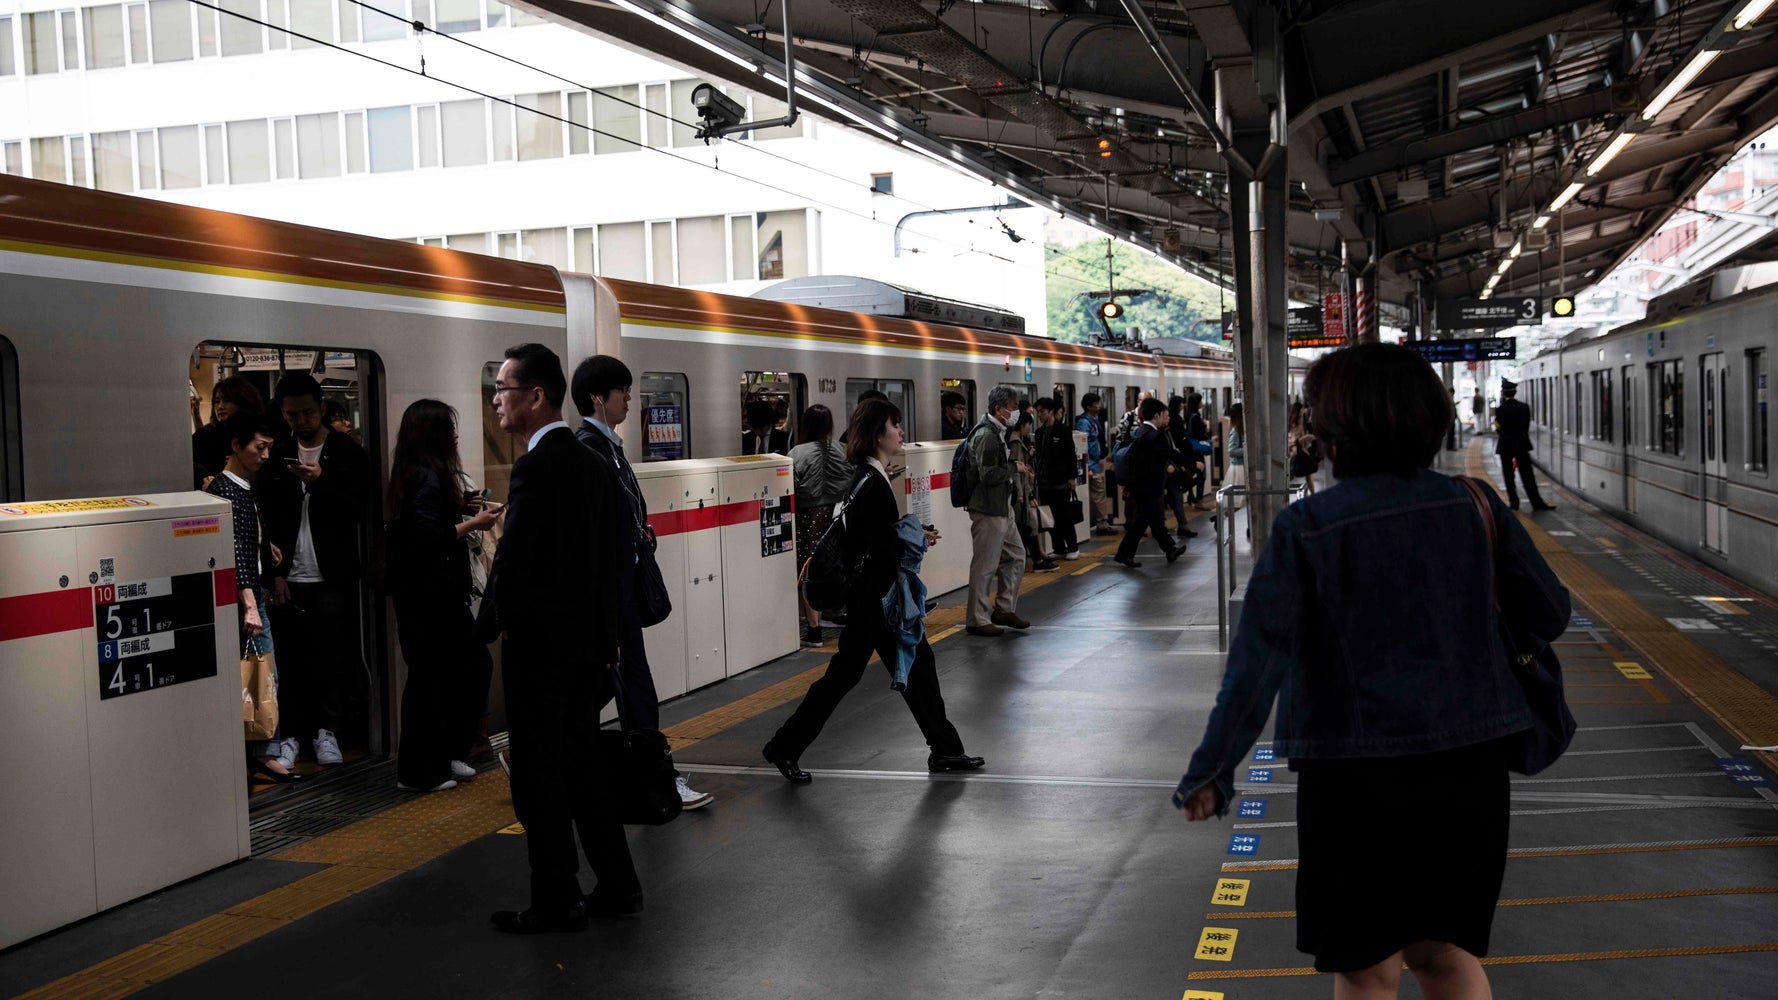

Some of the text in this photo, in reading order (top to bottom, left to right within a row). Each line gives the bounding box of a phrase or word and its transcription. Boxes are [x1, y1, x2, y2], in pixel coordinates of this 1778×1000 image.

[1522, 298, 1536, 319] 3
[651, 408, 674, 423] 優先席
[98, 582, 148, 602] 10 両編成
[106, 604, 123, 639] 5
[143, 607, 151, 632] 1
[104, 638, 151, 658] 8 両編成
[108, 660, 127, 694] 4
[146, 663, 154, 688] 1
[1216, 882, 1244, 902] 後発
[1201, 932, 1232, 956] 後発
